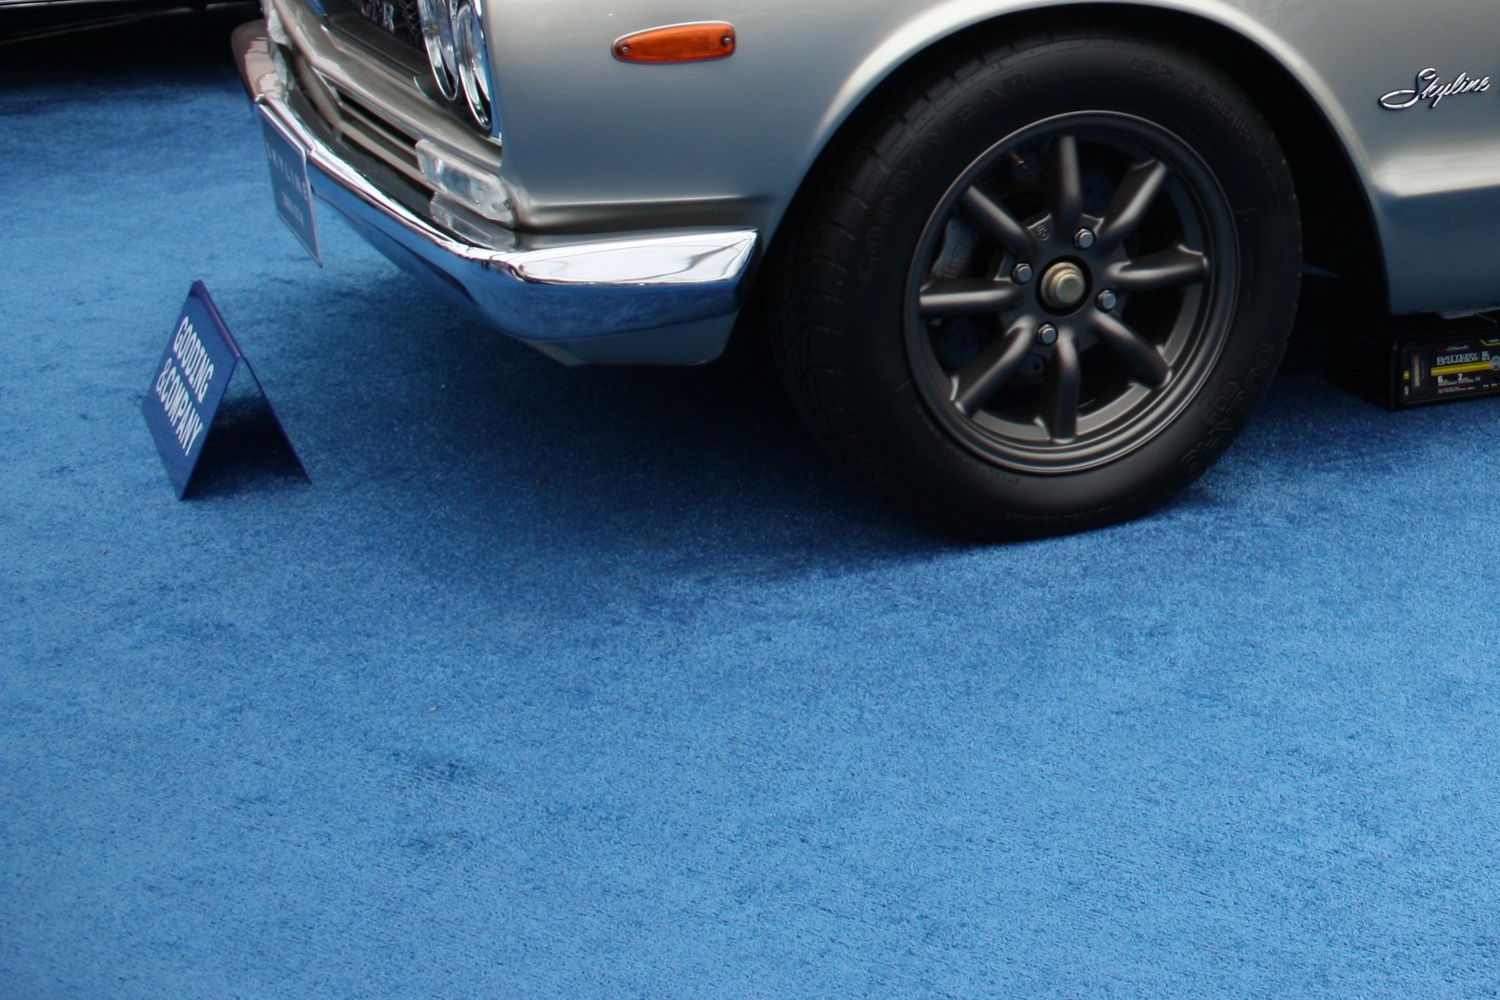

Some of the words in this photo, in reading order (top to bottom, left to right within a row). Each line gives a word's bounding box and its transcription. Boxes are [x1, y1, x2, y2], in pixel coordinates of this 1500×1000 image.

[1379, 67, 1491, 109] Skyline
[173, 316, 214, 404] GOODING
[156, 357, 204, 457] &COMPANY
